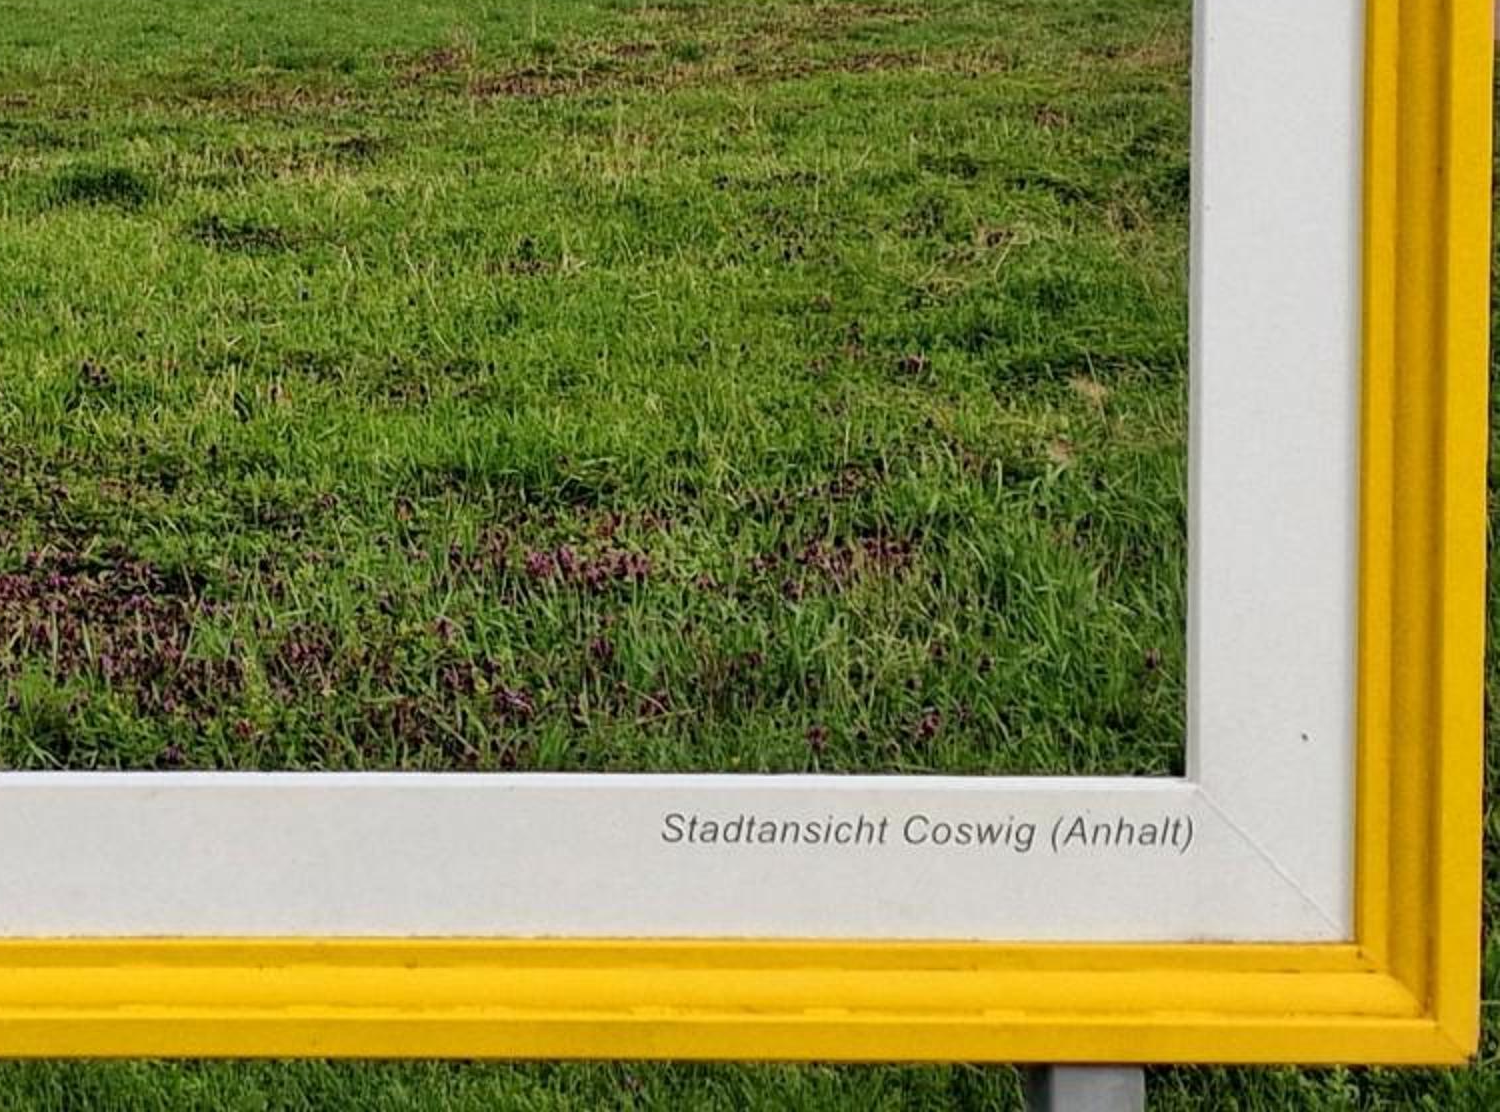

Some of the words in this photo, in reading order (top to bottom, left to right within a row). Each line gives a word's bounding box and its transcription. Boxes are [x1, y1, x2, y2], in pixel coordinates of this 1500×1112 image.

[661, 813, 888, 845] Stadtansicht
[903, 814, 1036, 853] Coswig
[1051, 815, 1193, 853] (Anhalt)
